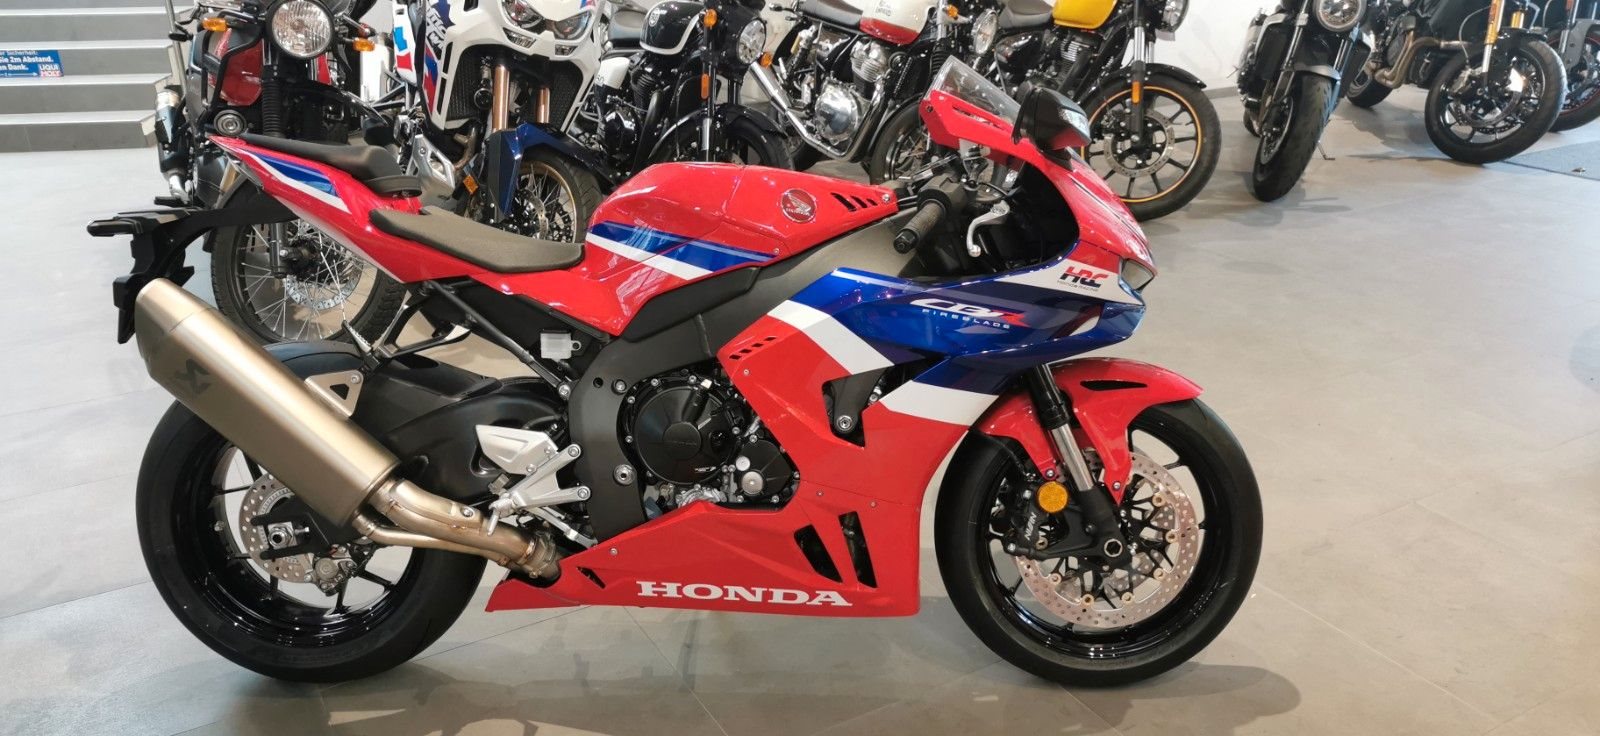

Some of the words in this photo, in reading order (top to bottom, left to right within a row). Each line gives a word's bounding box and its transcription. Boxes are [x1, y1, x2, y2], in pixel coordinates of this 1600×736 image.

[1060, 266, 1109, 289] HRC
[922, 308, 1010, 329] FIREBLADE
[635, 580, 853, 607] HONDA
